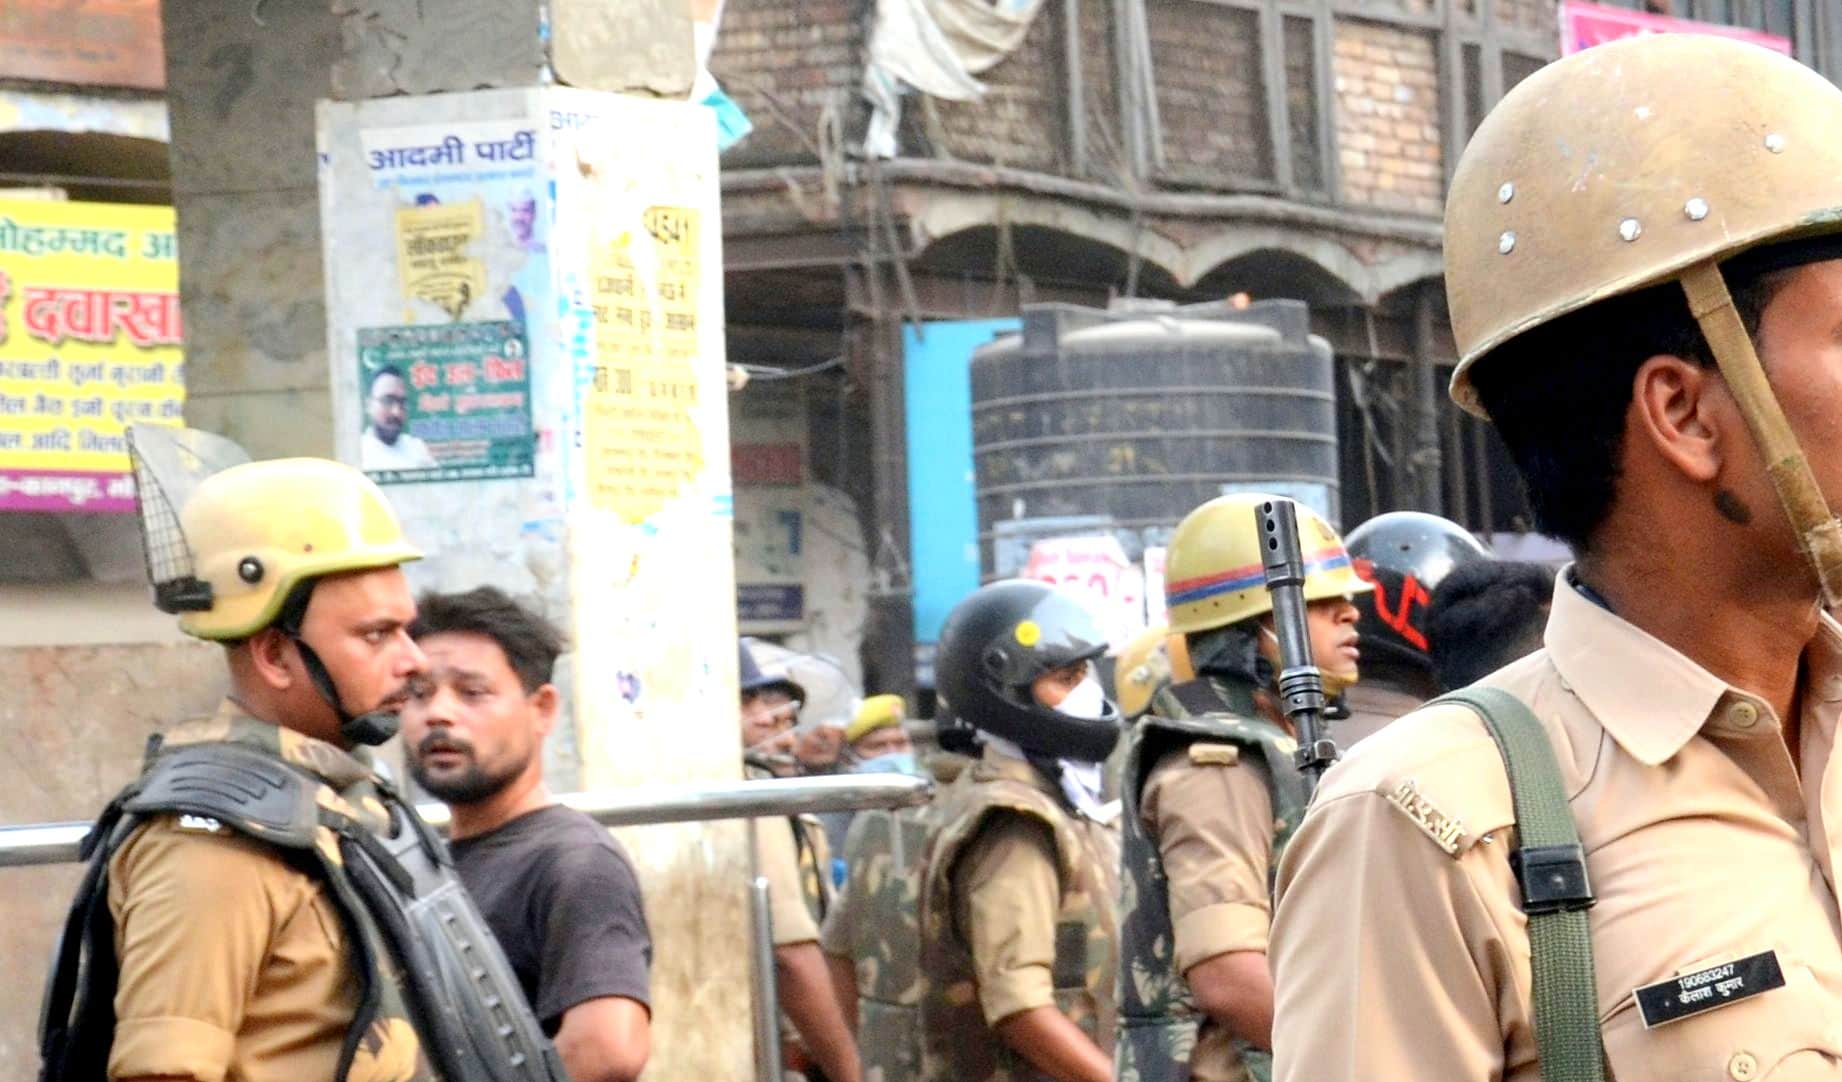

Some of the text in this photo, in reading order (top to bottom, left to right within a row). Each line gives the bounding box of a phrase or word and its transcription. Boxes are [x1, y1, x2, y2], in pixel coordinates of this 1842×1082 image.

[369, 135, 464, 170] आदमी
[475, 129, 536, 162] पार्टी
[23, 287, 184, 344] दवाखा
[1678, 964, 1735, 990] 190683247
[1715, 976, 1744, 997] कुमार
